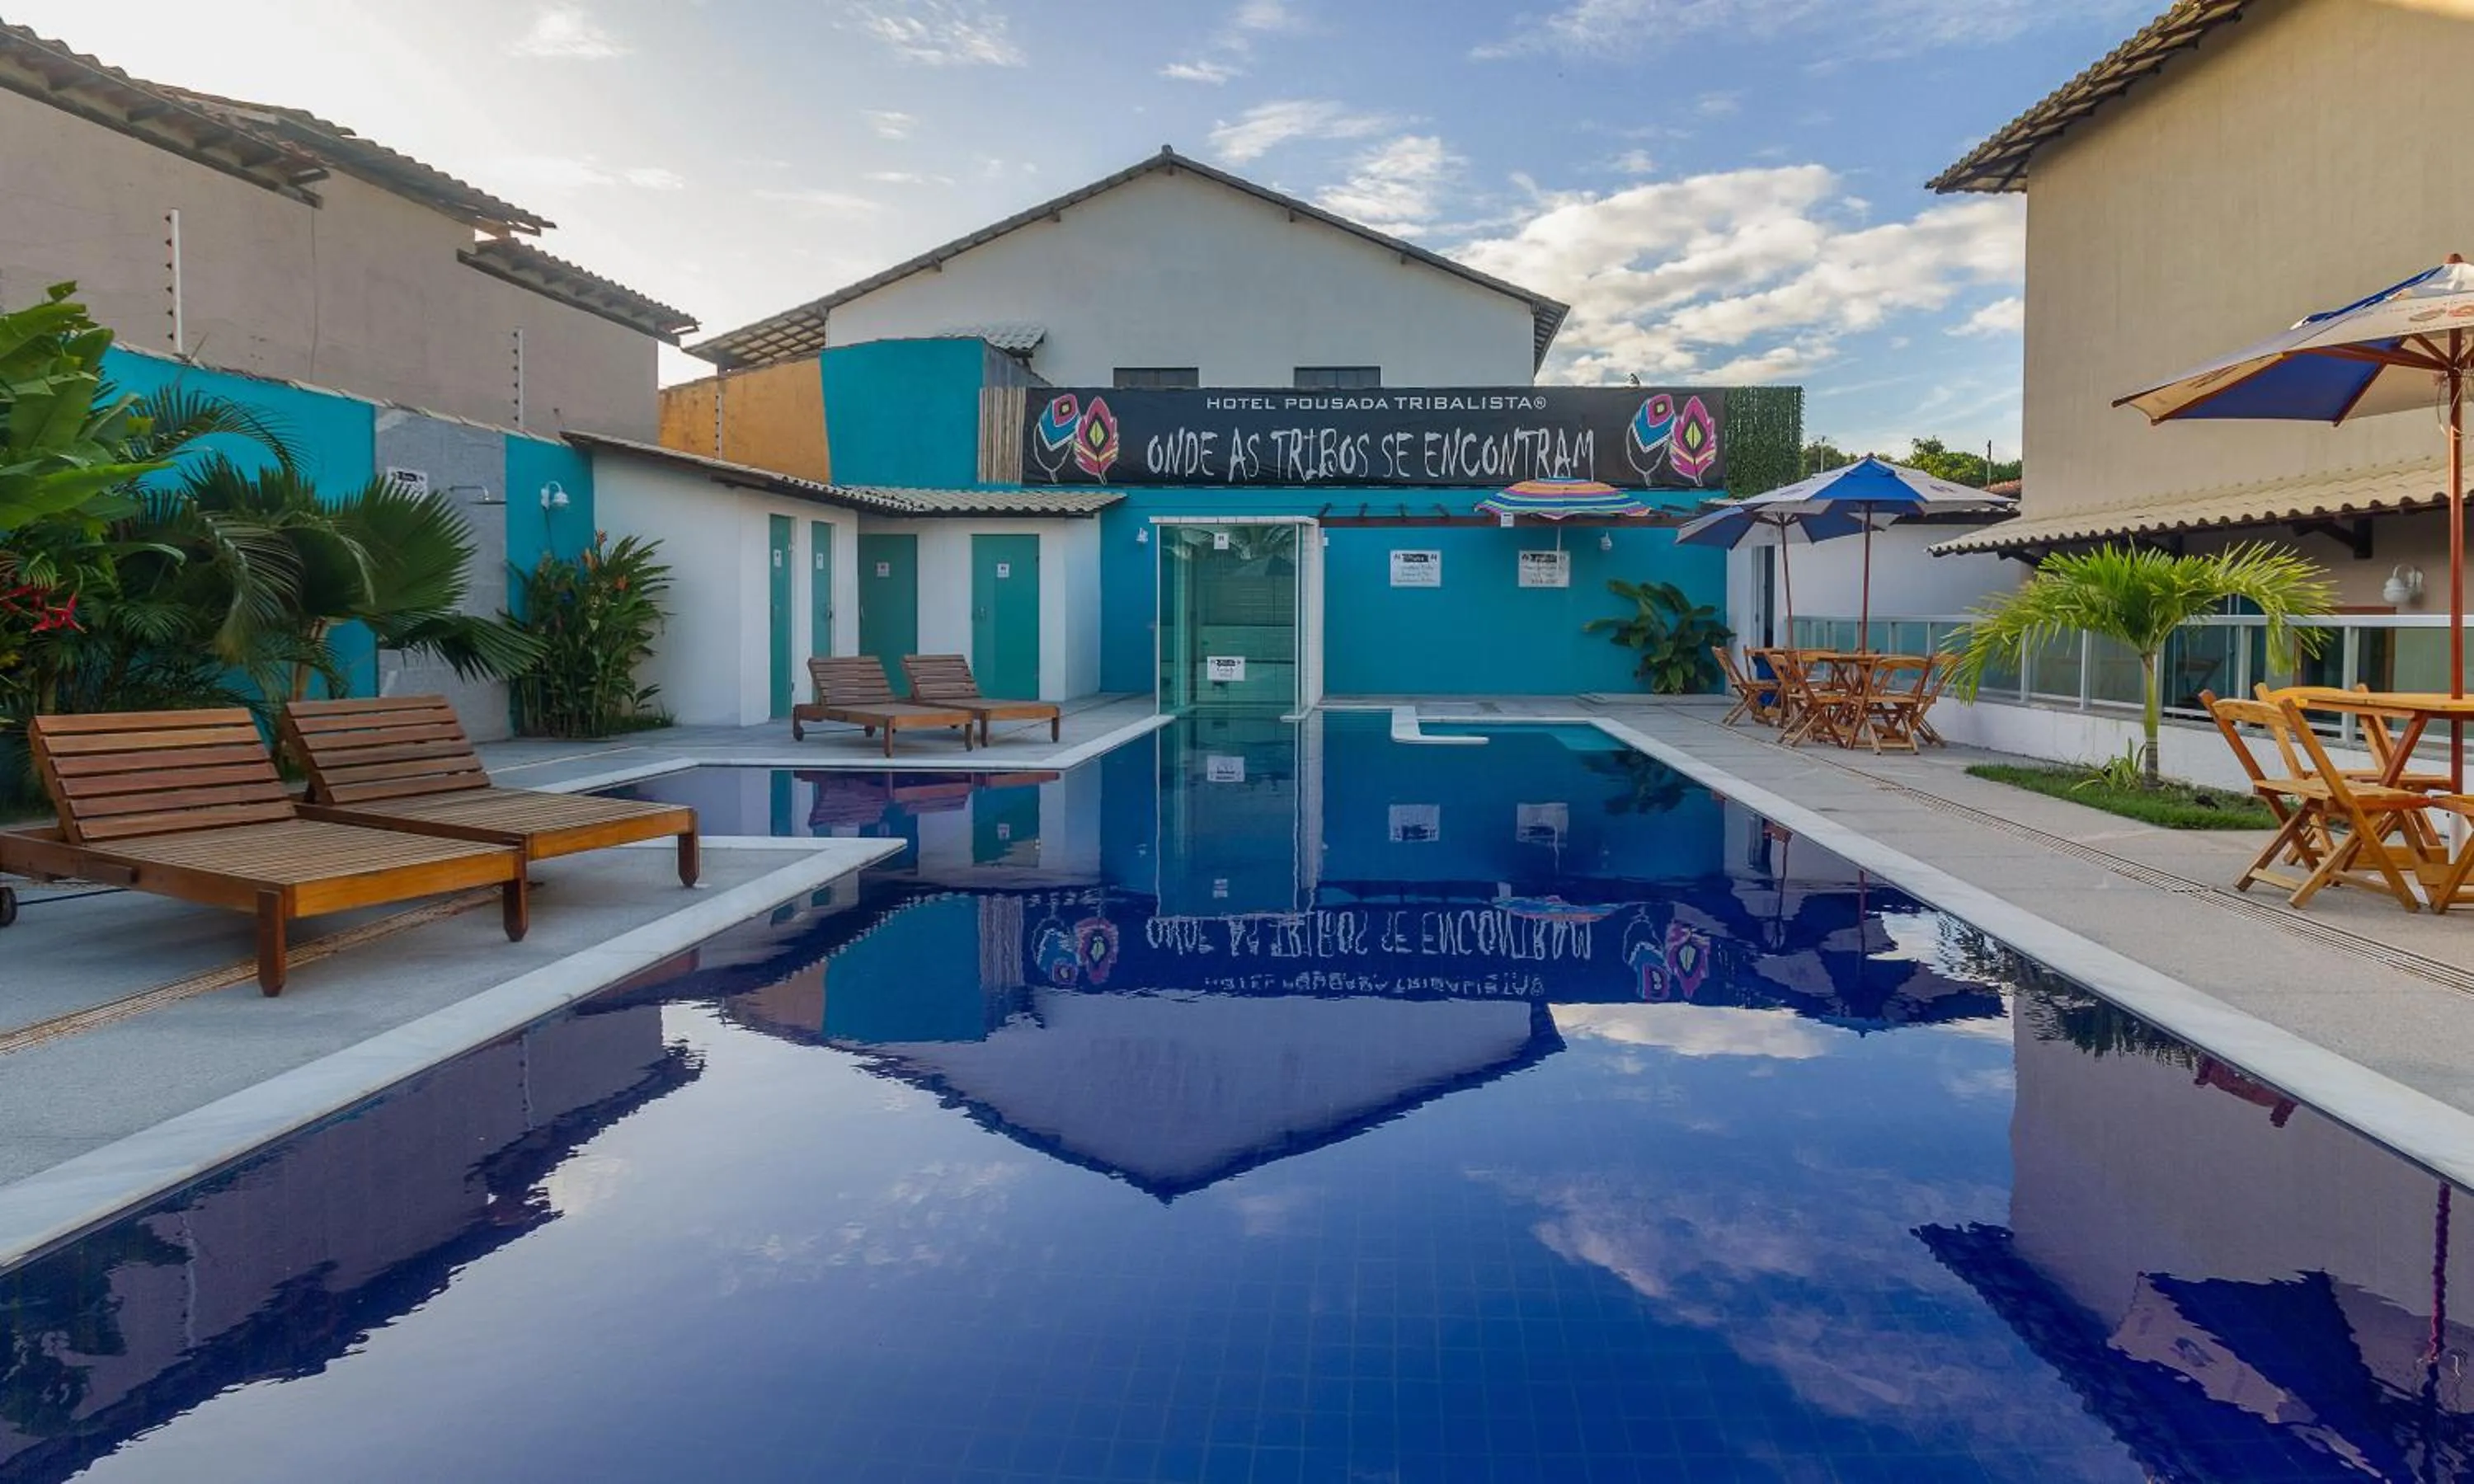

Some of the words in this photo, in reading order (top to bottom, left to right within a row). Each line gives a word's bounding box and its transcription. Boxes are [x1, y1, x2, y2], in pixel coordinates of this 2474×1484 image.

[1206, 397, 1276, 410] HOTEL
[1285, 397, 1389, 410] POUSADA
[1147, 426, 1218, 477] ONDE
[1228, 426, 1260, 482] AS
[1270, 428, 1370, 482] TRIBOS
[1381, 431, 1414, 477] SE
[1424, 425, 1595, 481] ENCONTRAM
